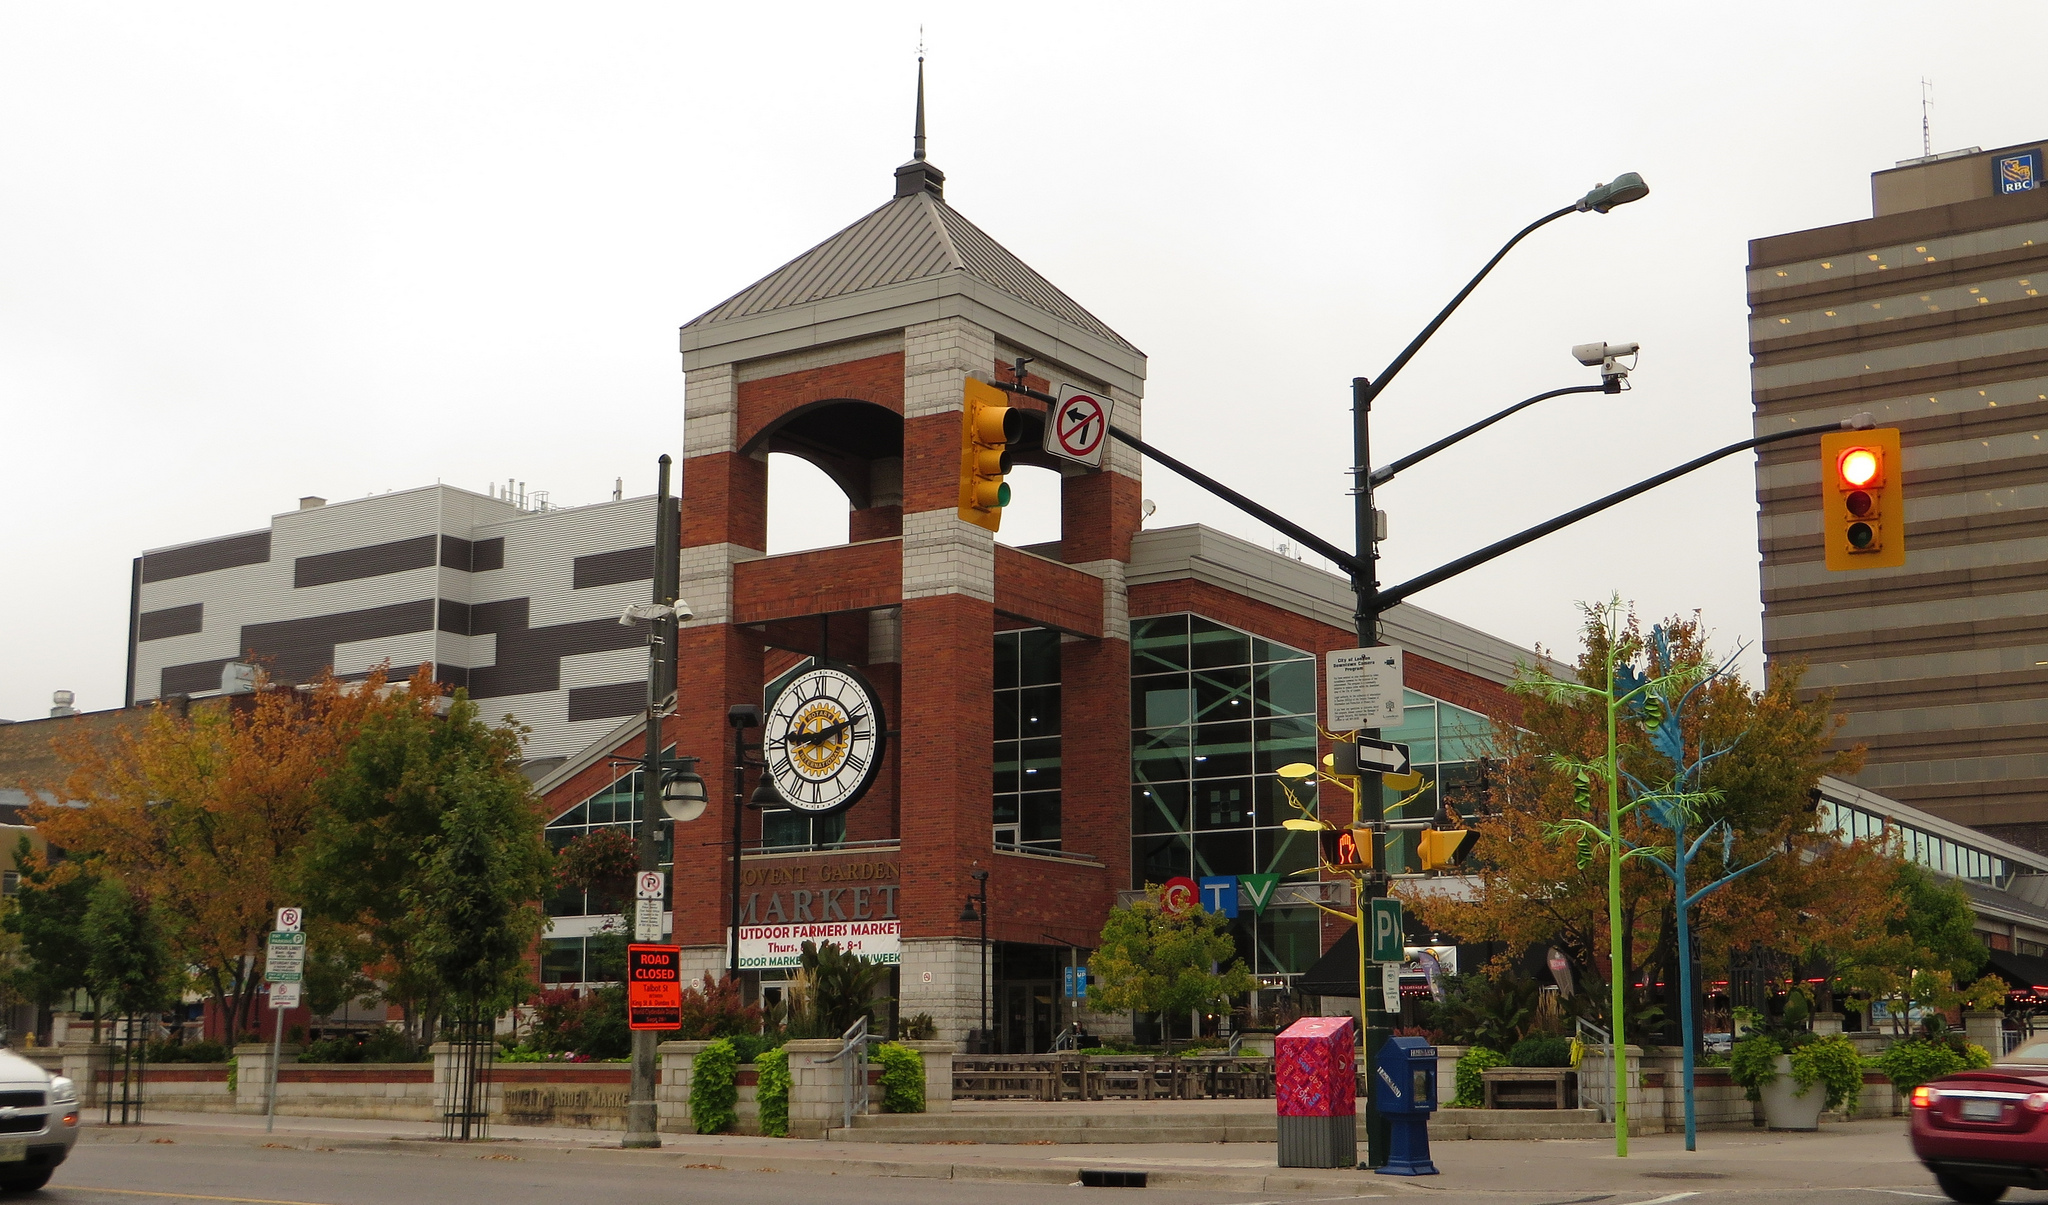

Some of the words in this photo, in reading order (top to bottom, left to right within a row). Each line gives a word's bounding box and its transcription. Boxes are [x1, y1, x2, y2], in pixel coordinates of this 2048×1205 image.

[2006, 180, 2030, 192] RBC
[808, 711, 831, 719] ROTARY
[800, 748, 840, 768] INTERNATIONAL
[740, 865, 808, 886] OVENT
[820, 862, 900, 882] GARDEN
[730, 885, 900, 924] MARKET
[1167, 880, 1272, 913] CTV
[739, 927, 790, 940] UTDOOR
[793, 924, 847, 938] FARMERS
[851, 922, 900, 936] MARKET
[1377, 910, 1392, 950] P
[768, 942, 798, 953] Thurs.
[848, 941, 862, 950] 8-1
[641, 954, 670, 965] ROAD
[738, 958, 766, 967] DOOR
[769, 956, 802, 966] MARKE
[636, 969, 674, 979] CLOSED
[643, 984, 661, 992] Talbot
[663, 984, 668, 992] St
[592, 1090, 629, 1108] MARKE
[1293, 1085, 1310, 1104] T9K
